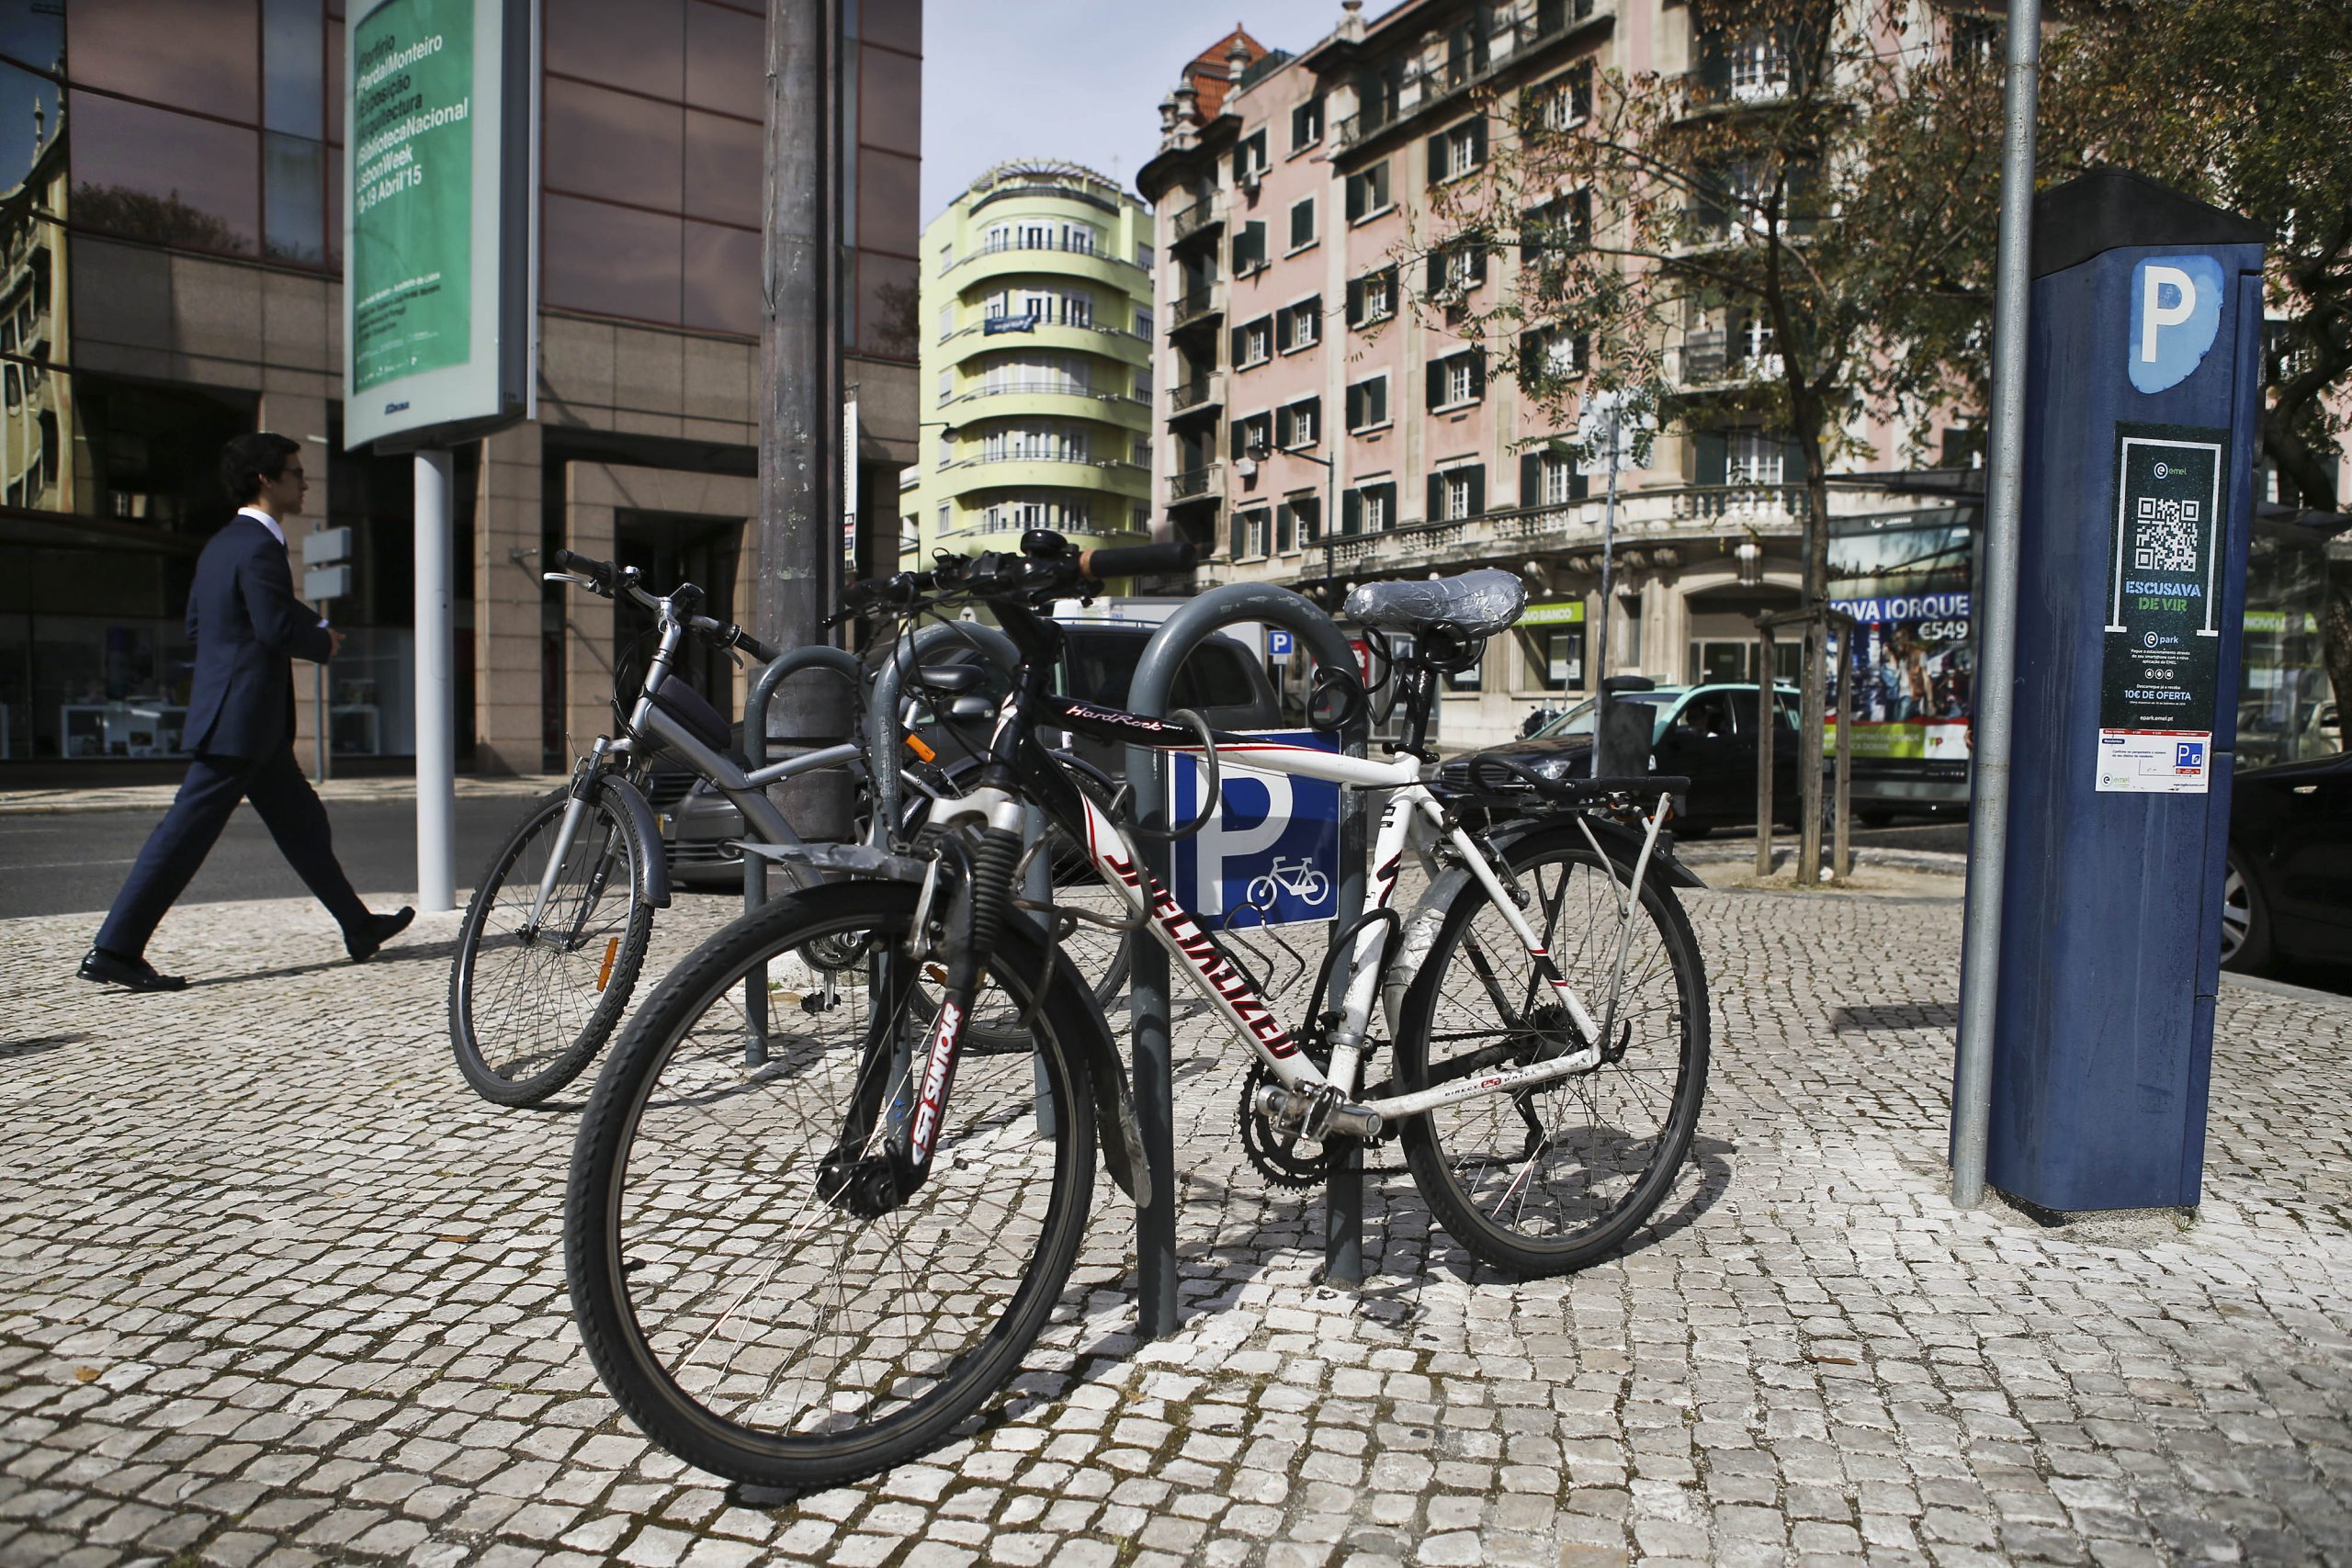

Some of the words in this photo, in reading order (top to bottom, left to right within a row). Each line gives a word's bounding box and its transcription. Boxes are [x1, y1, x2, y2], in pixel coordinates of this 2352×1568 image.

[2142, 265, 2196, 363] P
[2125, 581, 2200, 597] ESCUSAVA
[1884, 595, 1969, 619] IORQUE
[2138, 597, 2160, 611] DE
[2162, 598, 2187, 612] VIR
[1540, 608, 1572, 621] BANCO
[1917, 621, 1969, 640] €549
[1273, 634, 1287, 651] P
[2160, 636, 2178, 645] park
[2124, 690, 2141, 699] 10€
[2143, 690, 2154, 699] DE
[2156, 691, 2192, 701] OFERTA
[1066, 705, 1162, 731] HardRock
[2177, 745, 2190, 764] P
[1197, 753, 1293, 916] P
[924, 1002, 961, 1105] SUNTOUR
[913, 1102, 936, 1148] SR
